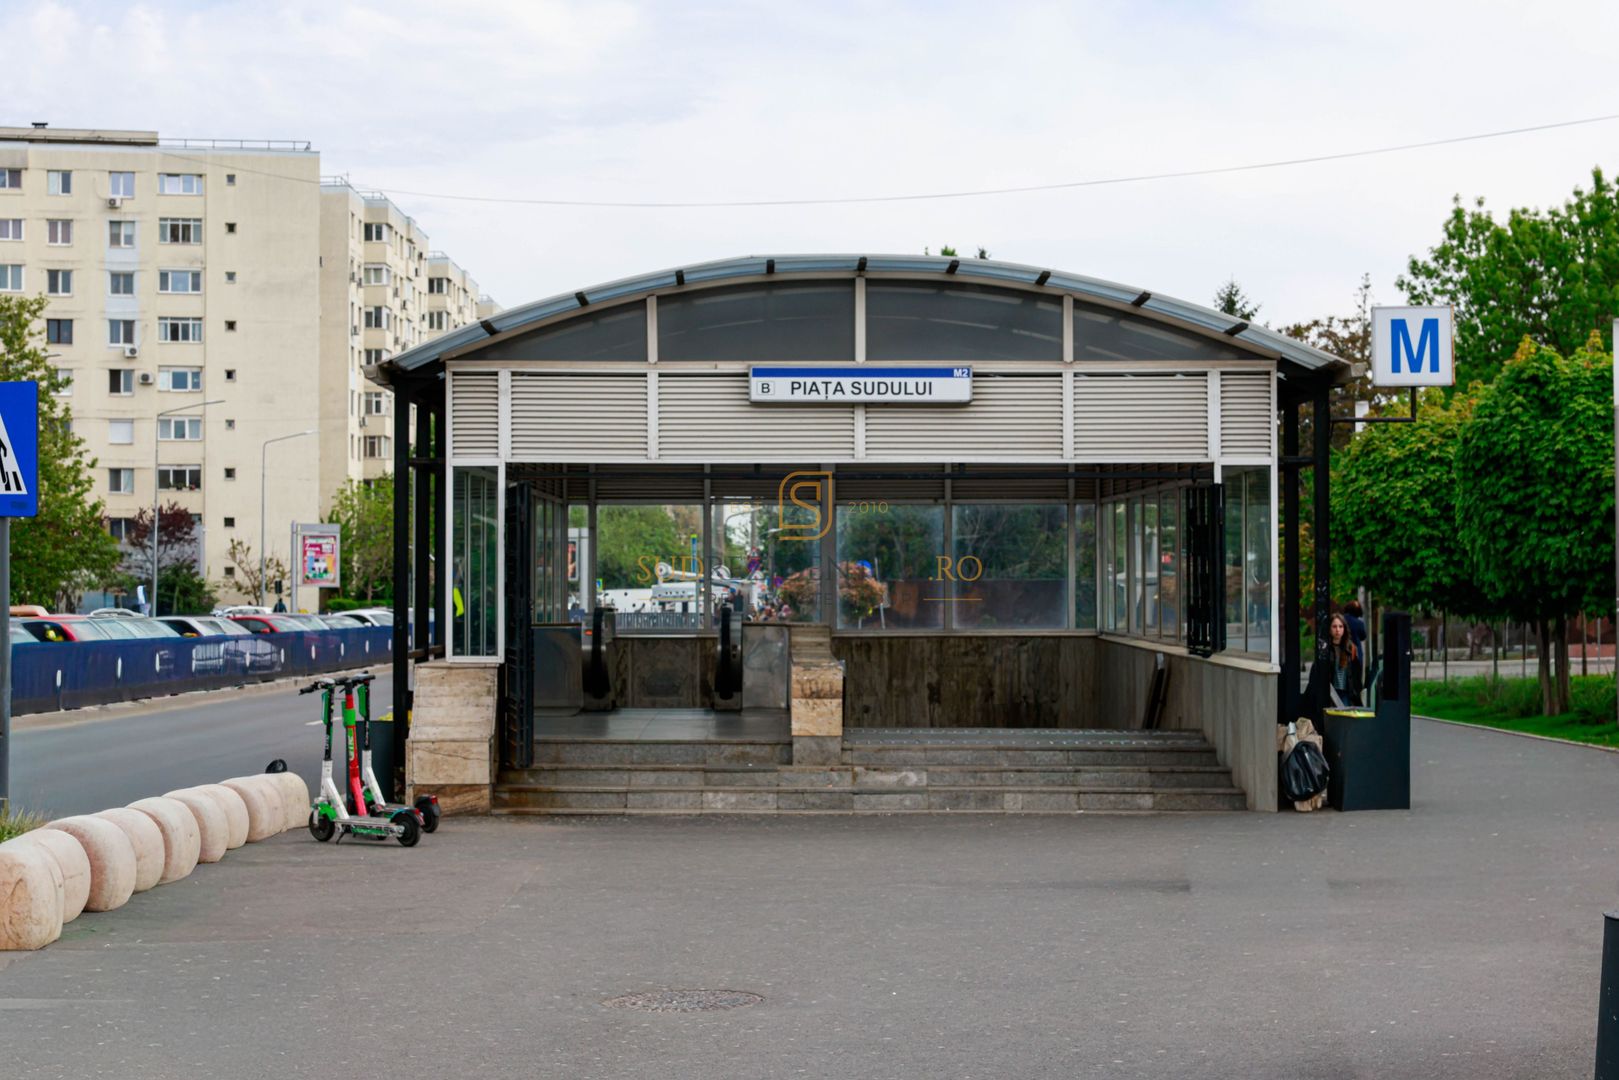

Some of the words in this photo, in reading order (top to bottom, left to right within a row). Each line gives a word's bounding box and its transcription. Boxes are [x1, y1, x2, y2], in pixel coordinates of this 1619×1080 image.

[1390, 318, 1440, 374] M
[953, 368, 969, 377] M2
[761, 383, 771, 393] B
[790, 381, 846, 399] PIAȚA
[850, 381, 933, 396] SUDULUI
